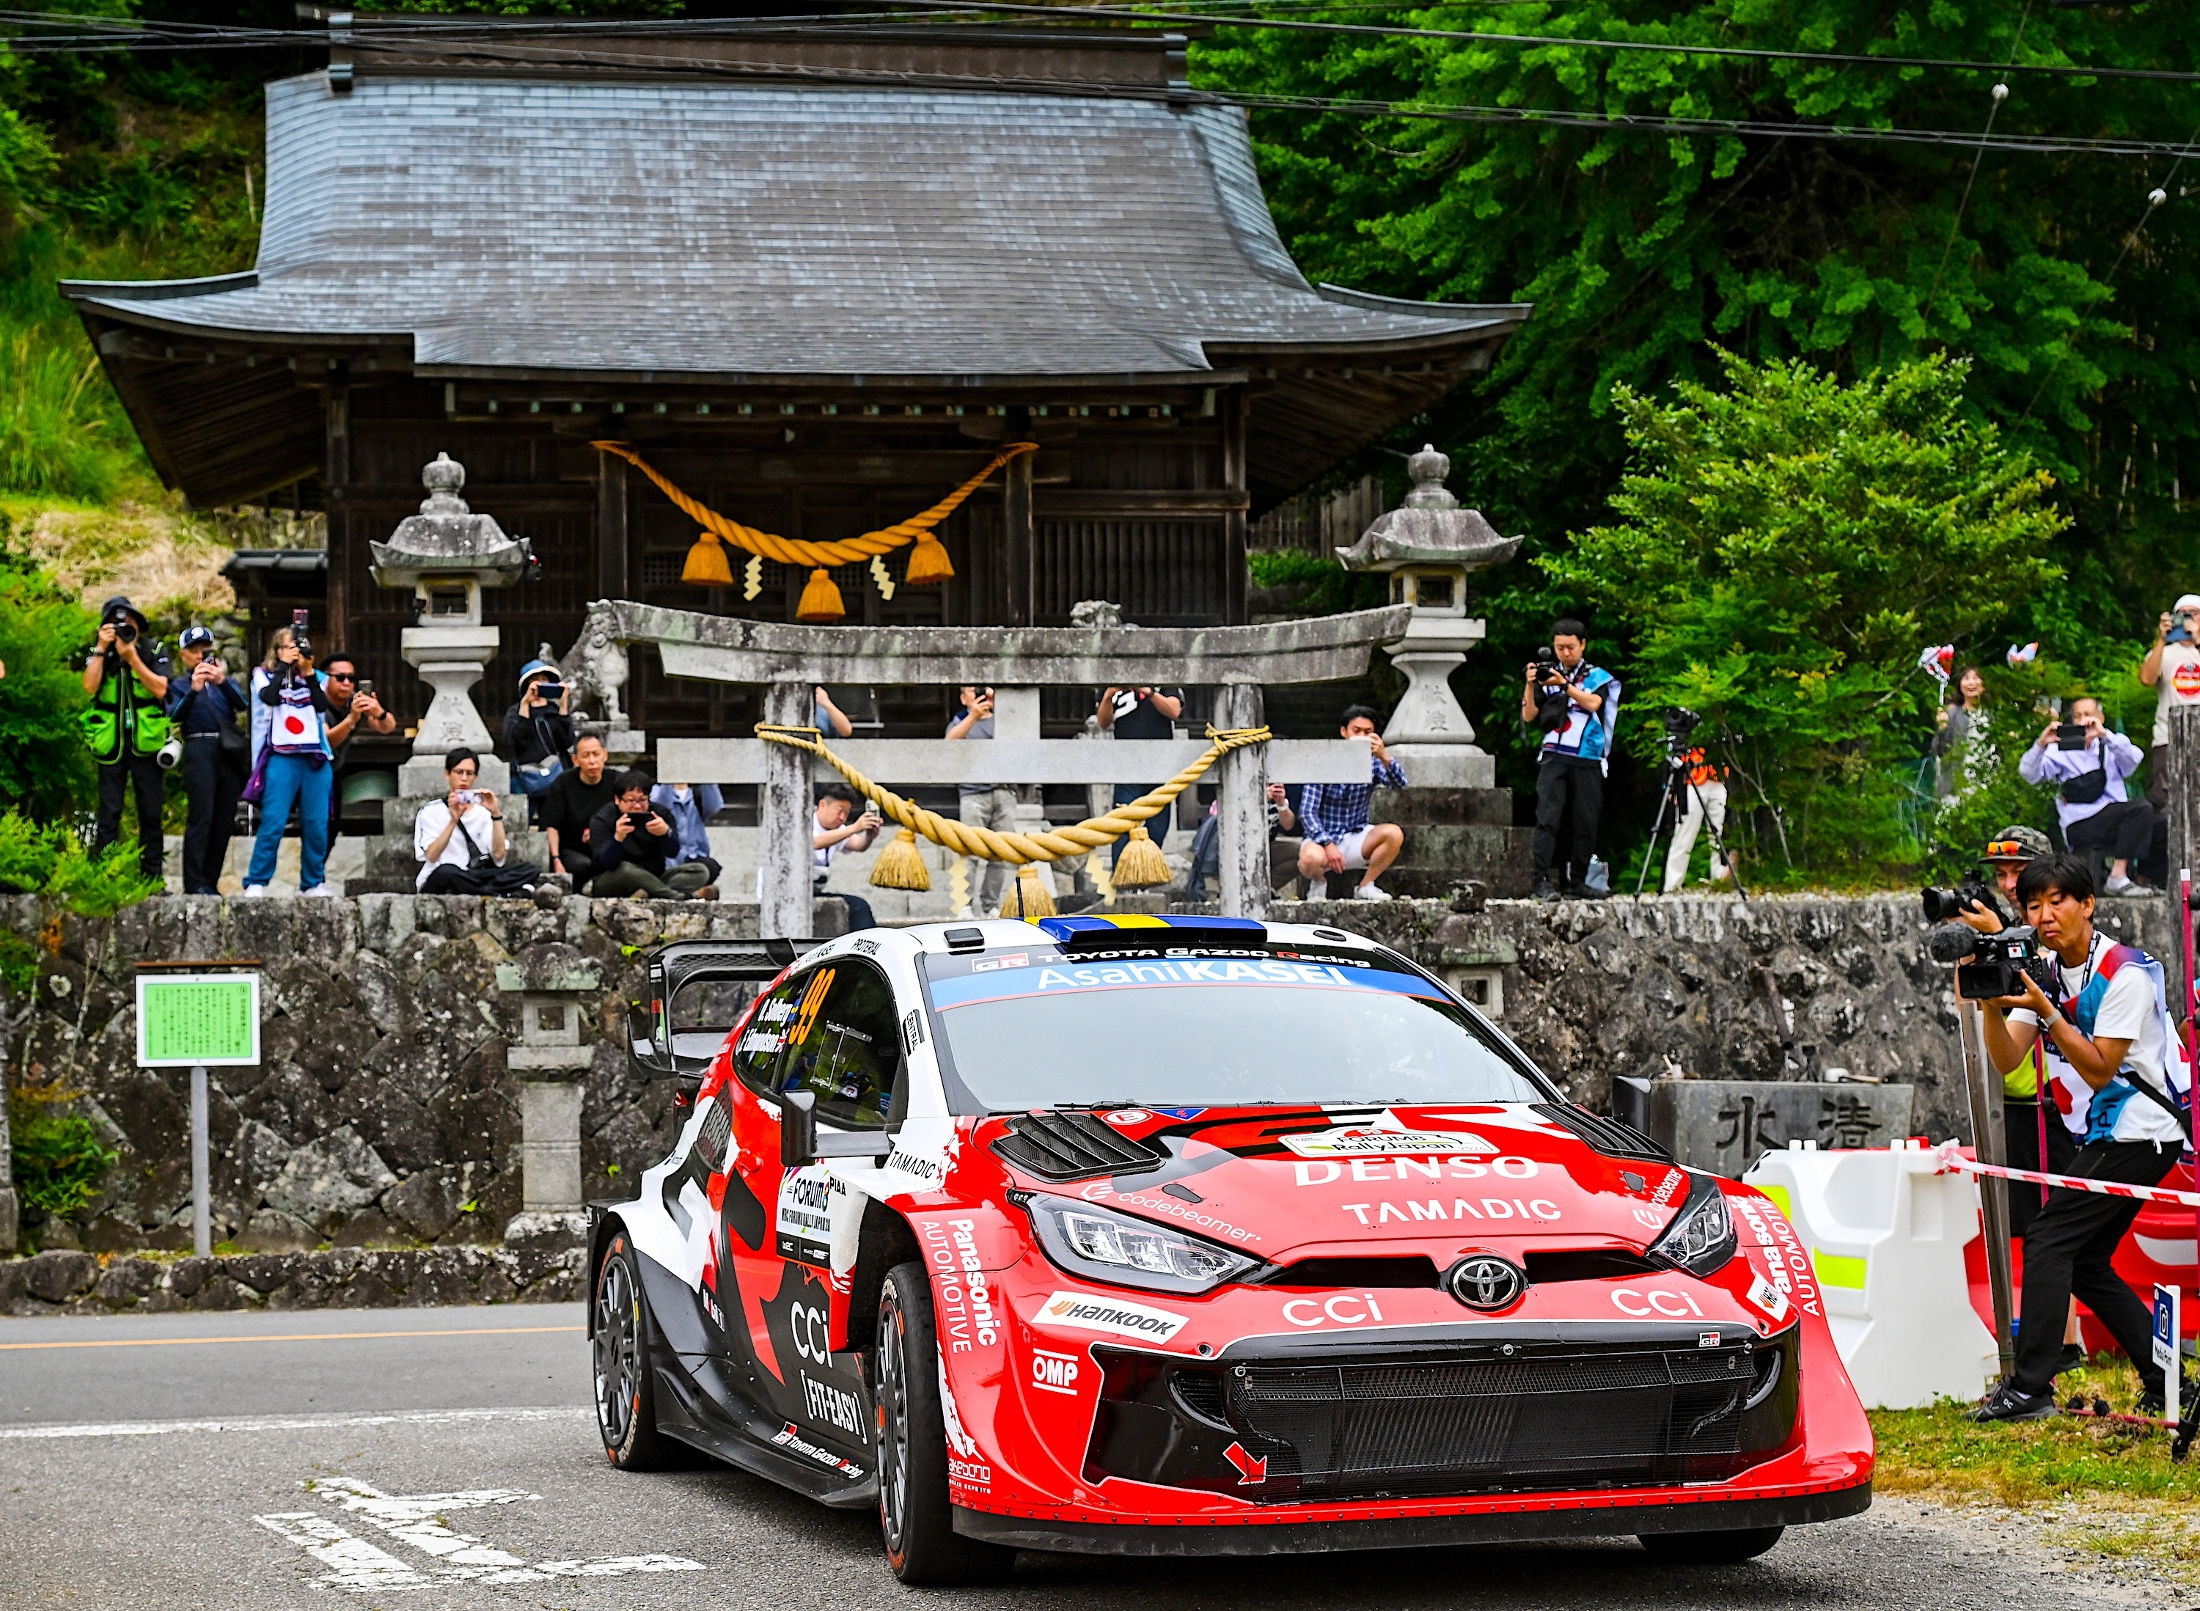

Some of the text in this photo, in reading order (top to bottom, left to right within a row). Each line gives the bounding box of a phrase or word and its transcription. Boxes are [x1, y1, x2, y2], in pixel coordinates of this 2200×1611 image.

[1038, 949, 1158, 963] TOYOTA
[1165, 947, 1270, 959] GAZOO
[1276, 951, 1371, 968] Racing
[788, 968, 836, 1045] 99
[1336, 1134, 1427, 1143] FORUM8
[890, 1150, 936, 1179] TAMADIC
[1292, 1156, 1540, 1187] DENSO
[792, 1177, 830, 1213] FORUM8
[829, 1176, 847, 1197] PIAA
[1117, 1192, 1260, 1243] codebeamer
[1341, 1198, 1562, 1225] TAMADIC
[1730, 1194, 1793, 1294] anasonic
[1748, 1194, 1820, 1317] AUTOMOTIVE
[920, 1221, 972, 1354] AUTOMOTIVE
[947, 1218, 1001, 1347] Panasonic
[1032, 1356, 1079, 1387] OMP
[786, 1436, 817, 1456] TOYOTA
[811, 1448, 841, 1466] GAZOO
[835, 1458, 865, 1478] Racing
